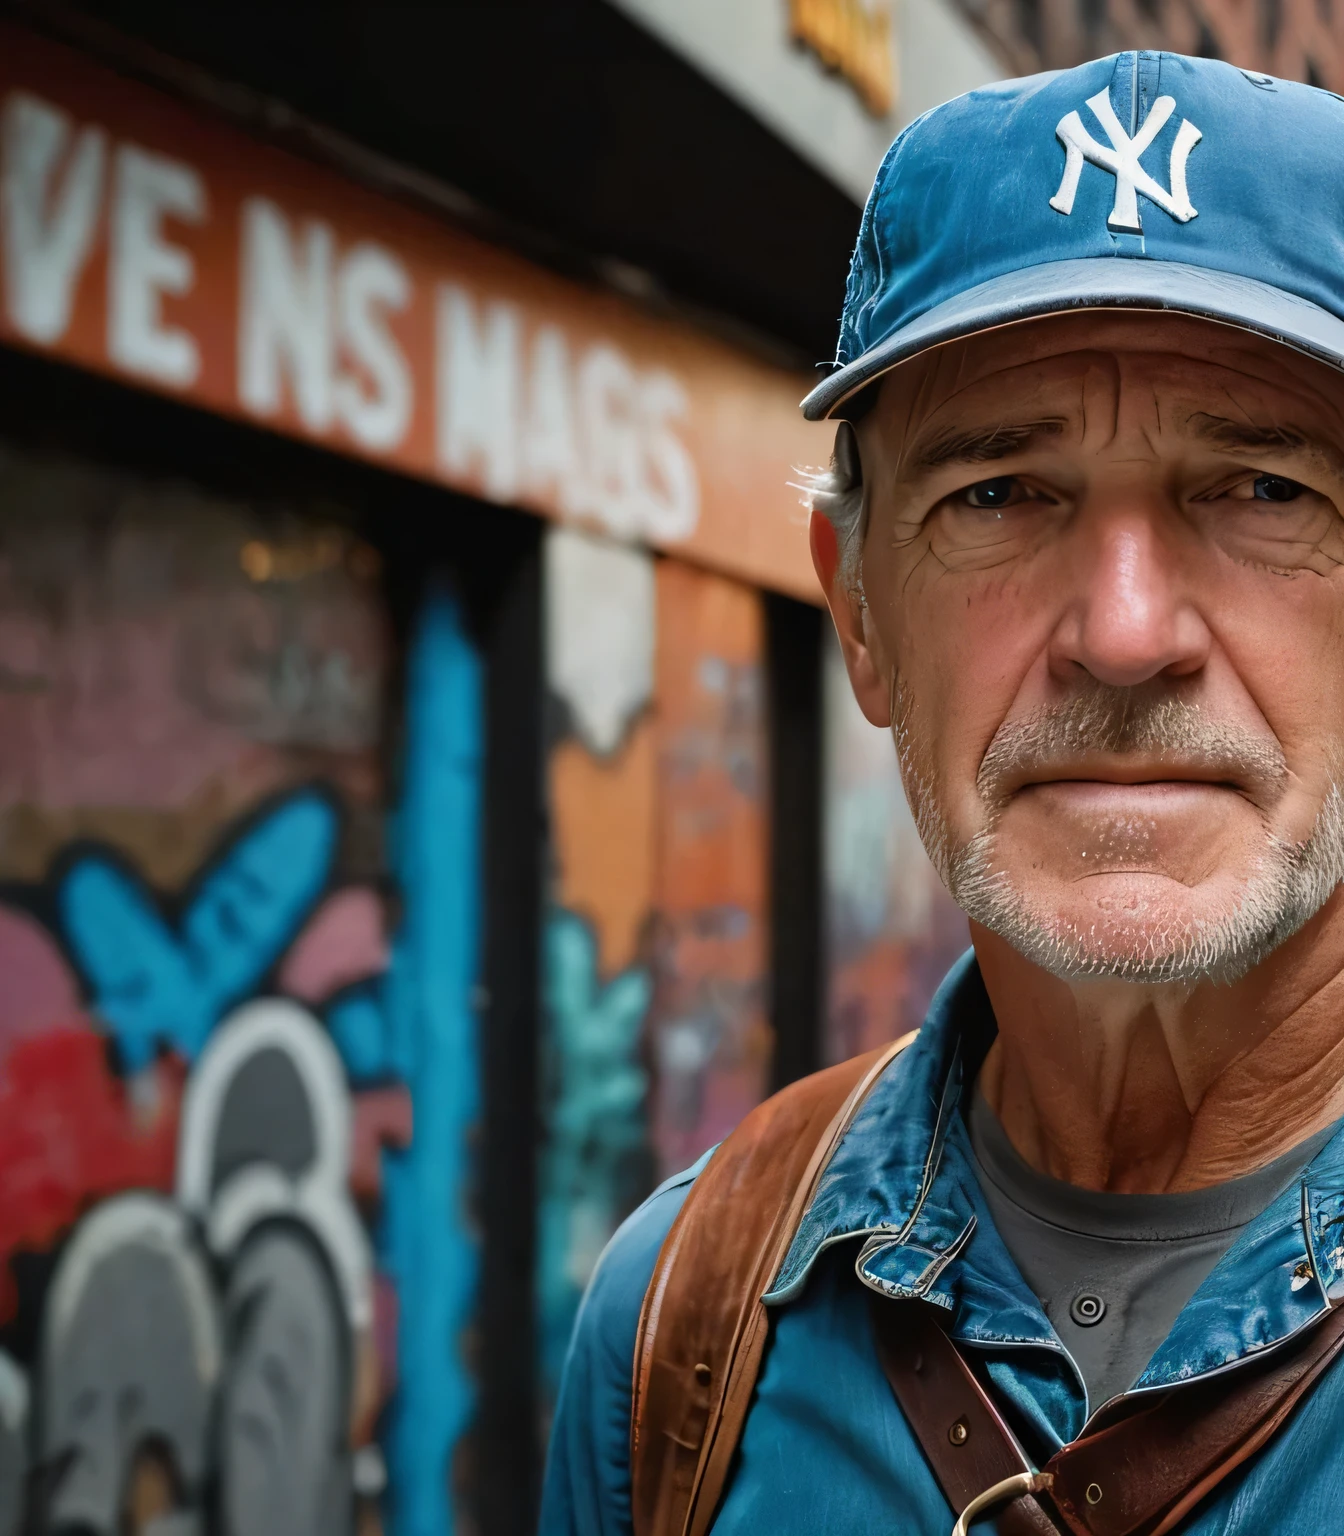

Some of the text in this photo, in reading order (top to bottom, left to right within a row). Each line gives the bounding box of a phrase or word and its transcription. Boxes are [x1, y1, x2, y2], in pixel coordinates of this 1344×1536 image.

[3, 91, 206, 388] VE
[237, 197, 412, 452] NS
[1049, 86, 1202, 233] NY
